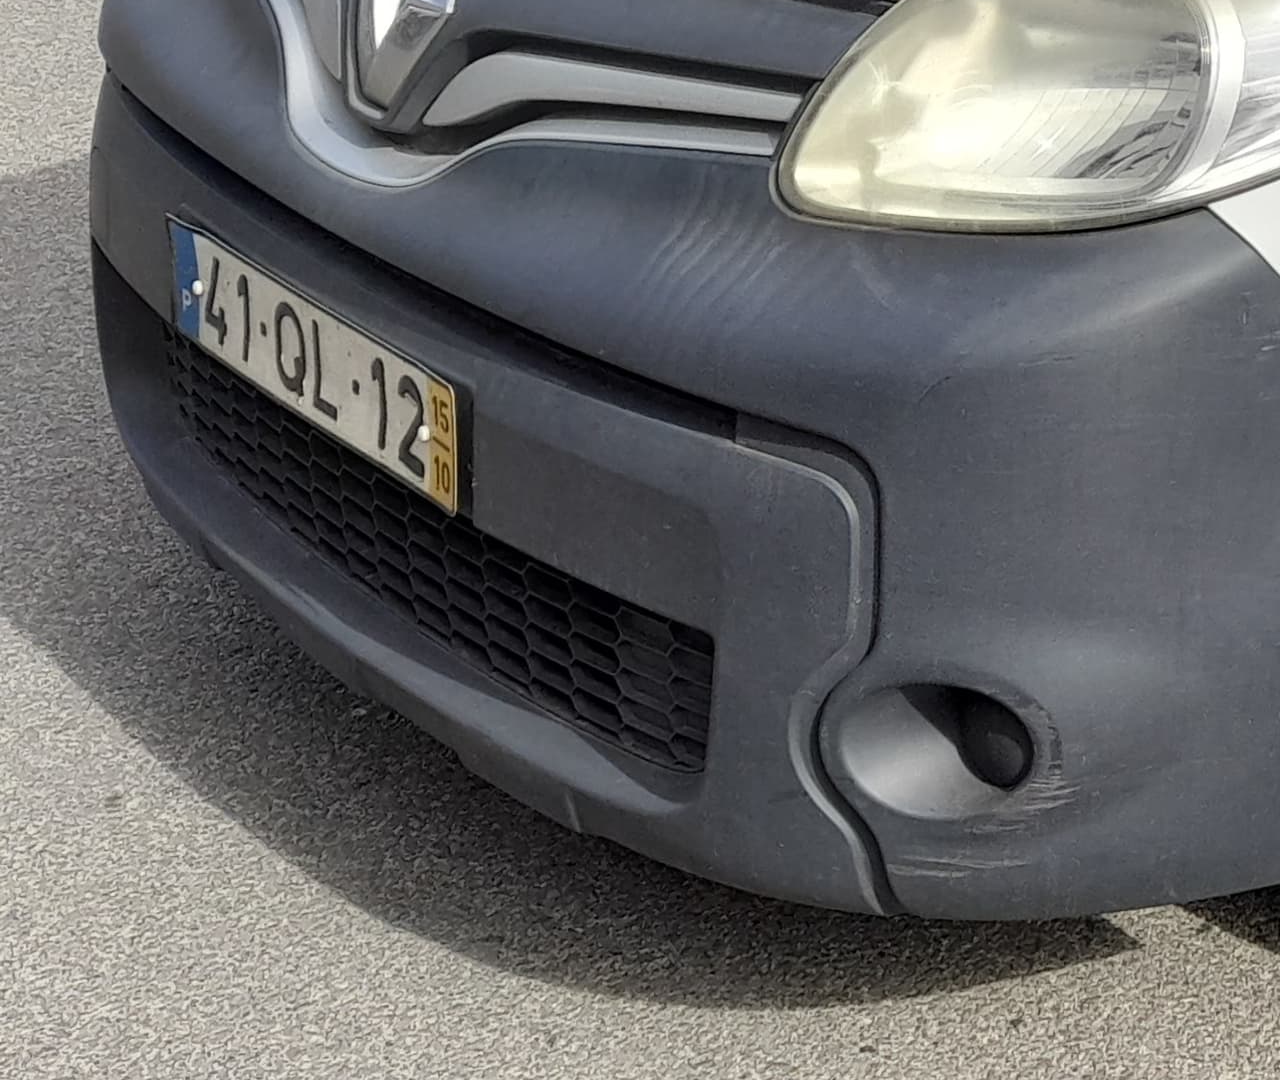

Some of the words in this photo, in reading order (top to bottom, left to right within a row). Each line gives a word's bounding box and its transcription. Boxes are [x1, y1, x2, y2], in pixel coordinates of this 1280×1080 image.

[181, 288, 193, 311] P
[431, 394, 450, 434] 15
[432, 454, 451, 495] 10
